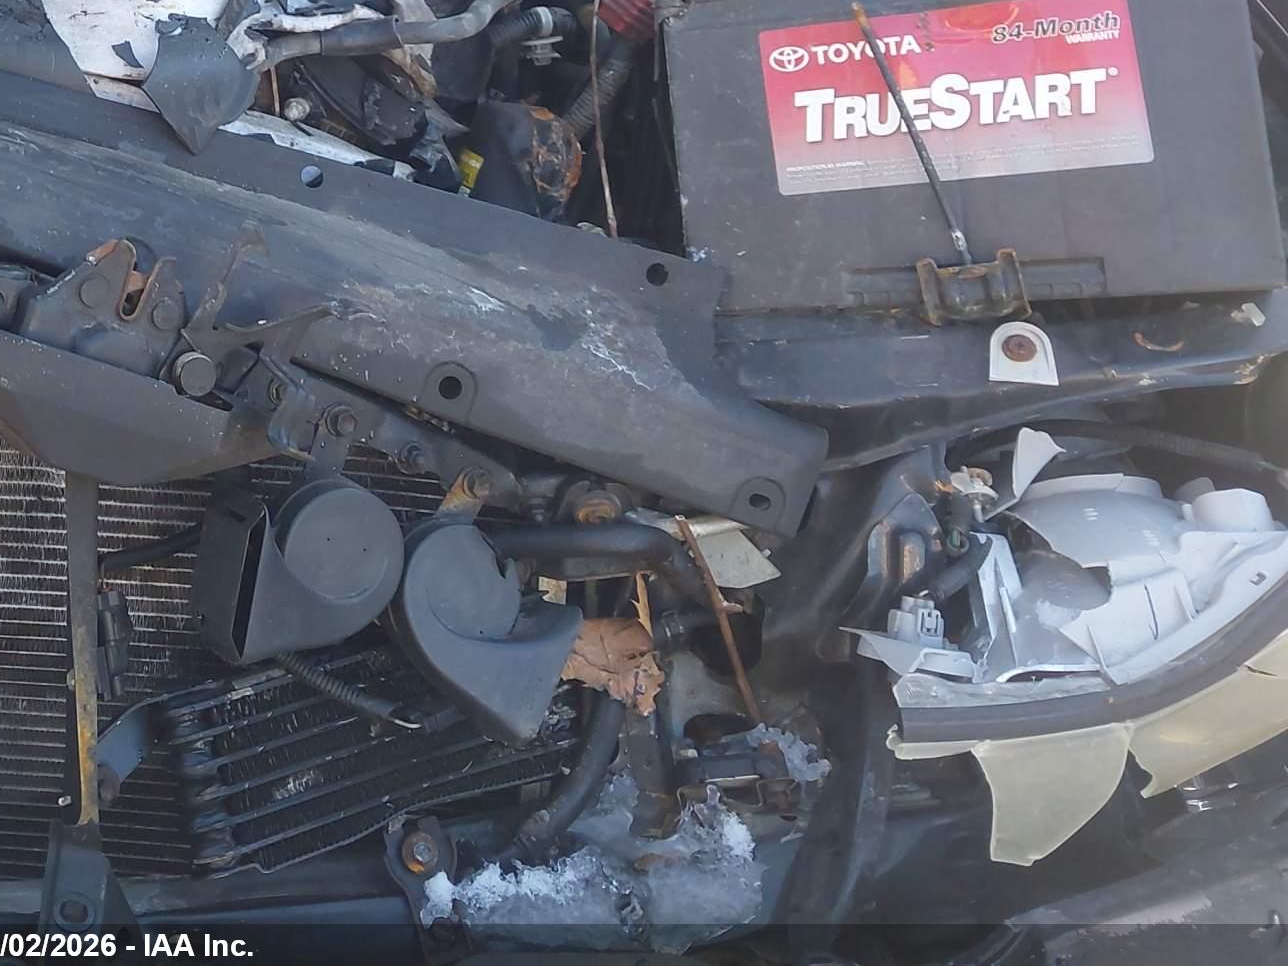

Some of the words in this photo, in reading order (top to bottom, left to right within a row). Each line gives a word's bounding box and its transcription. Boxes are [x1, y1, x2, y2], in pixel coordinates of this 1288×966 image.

[992, 10, 1121, 44] 84-Month
[1065, 29, 1120, 45] WARRANTY
[811, 35, 922, 65] TOYOTA
